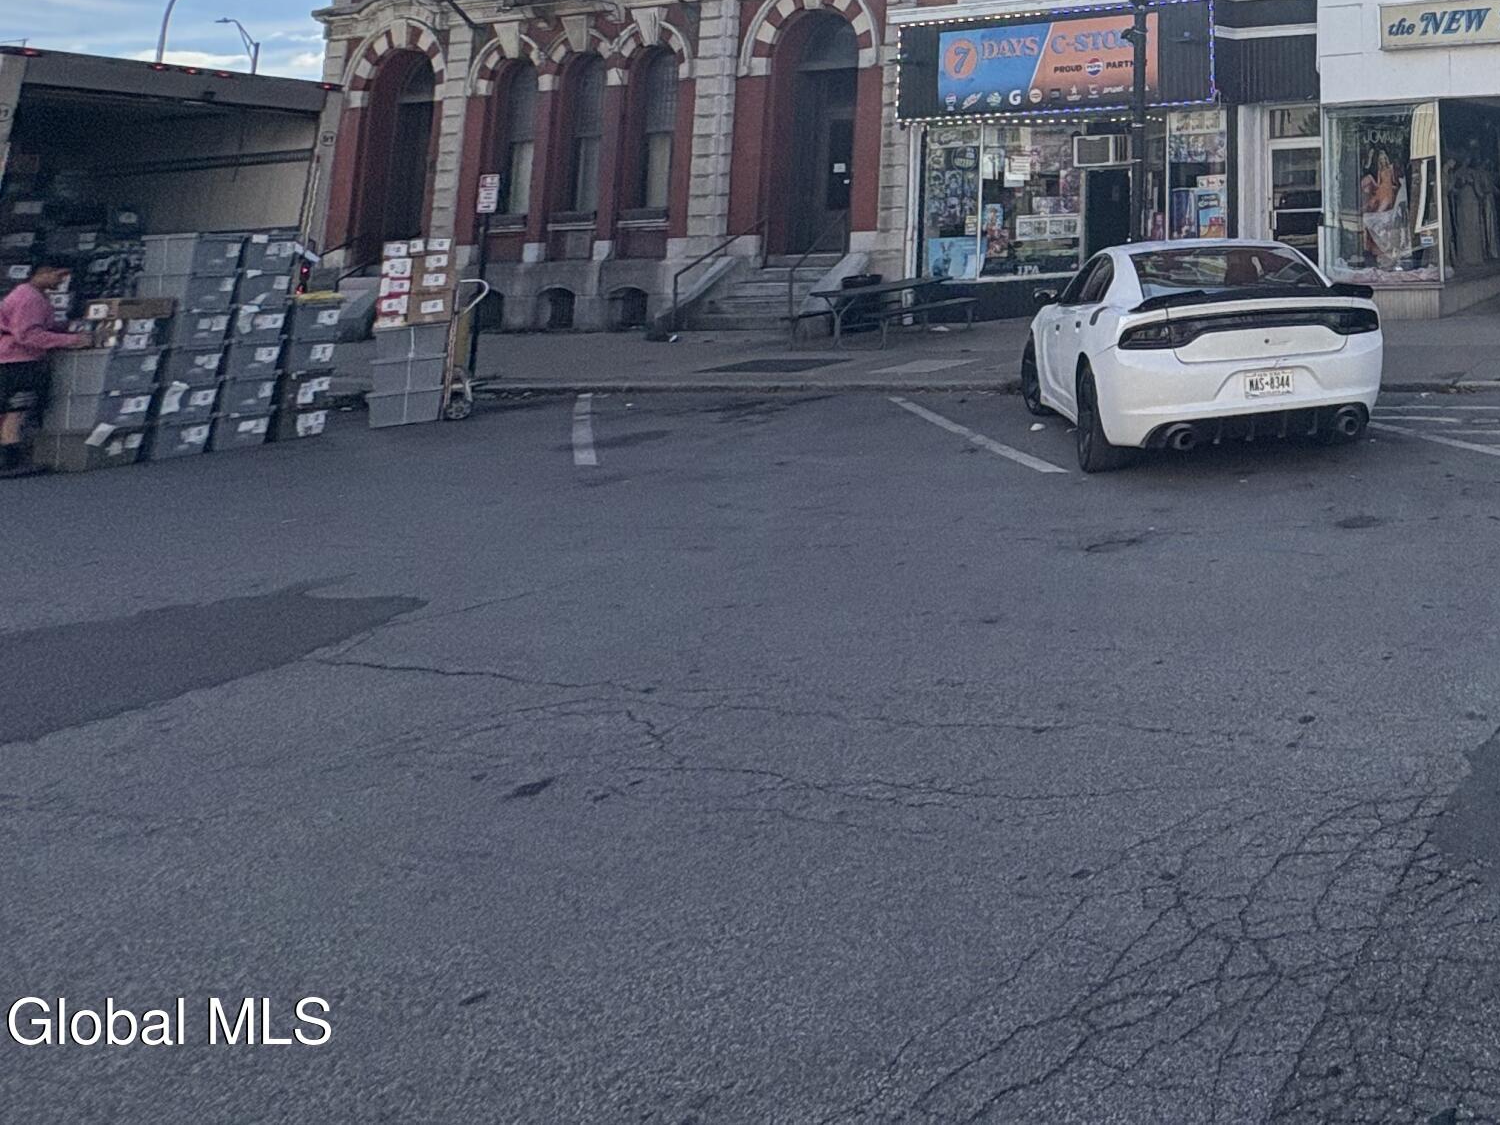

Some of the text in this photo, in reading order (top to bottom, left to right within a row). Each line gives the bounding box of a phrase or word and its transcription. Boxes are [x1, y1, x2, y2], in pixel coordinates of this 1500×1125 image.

[1388, 17, 1416, 37] the
[1419, 7, 1491, 36] NEW
[955, 46, 970, 74] 7
[981, 35, 1040, 60] DAYS
[1054, 64, 1083, 74] PROUD
[1017, 265, 1040, 276] IPA
